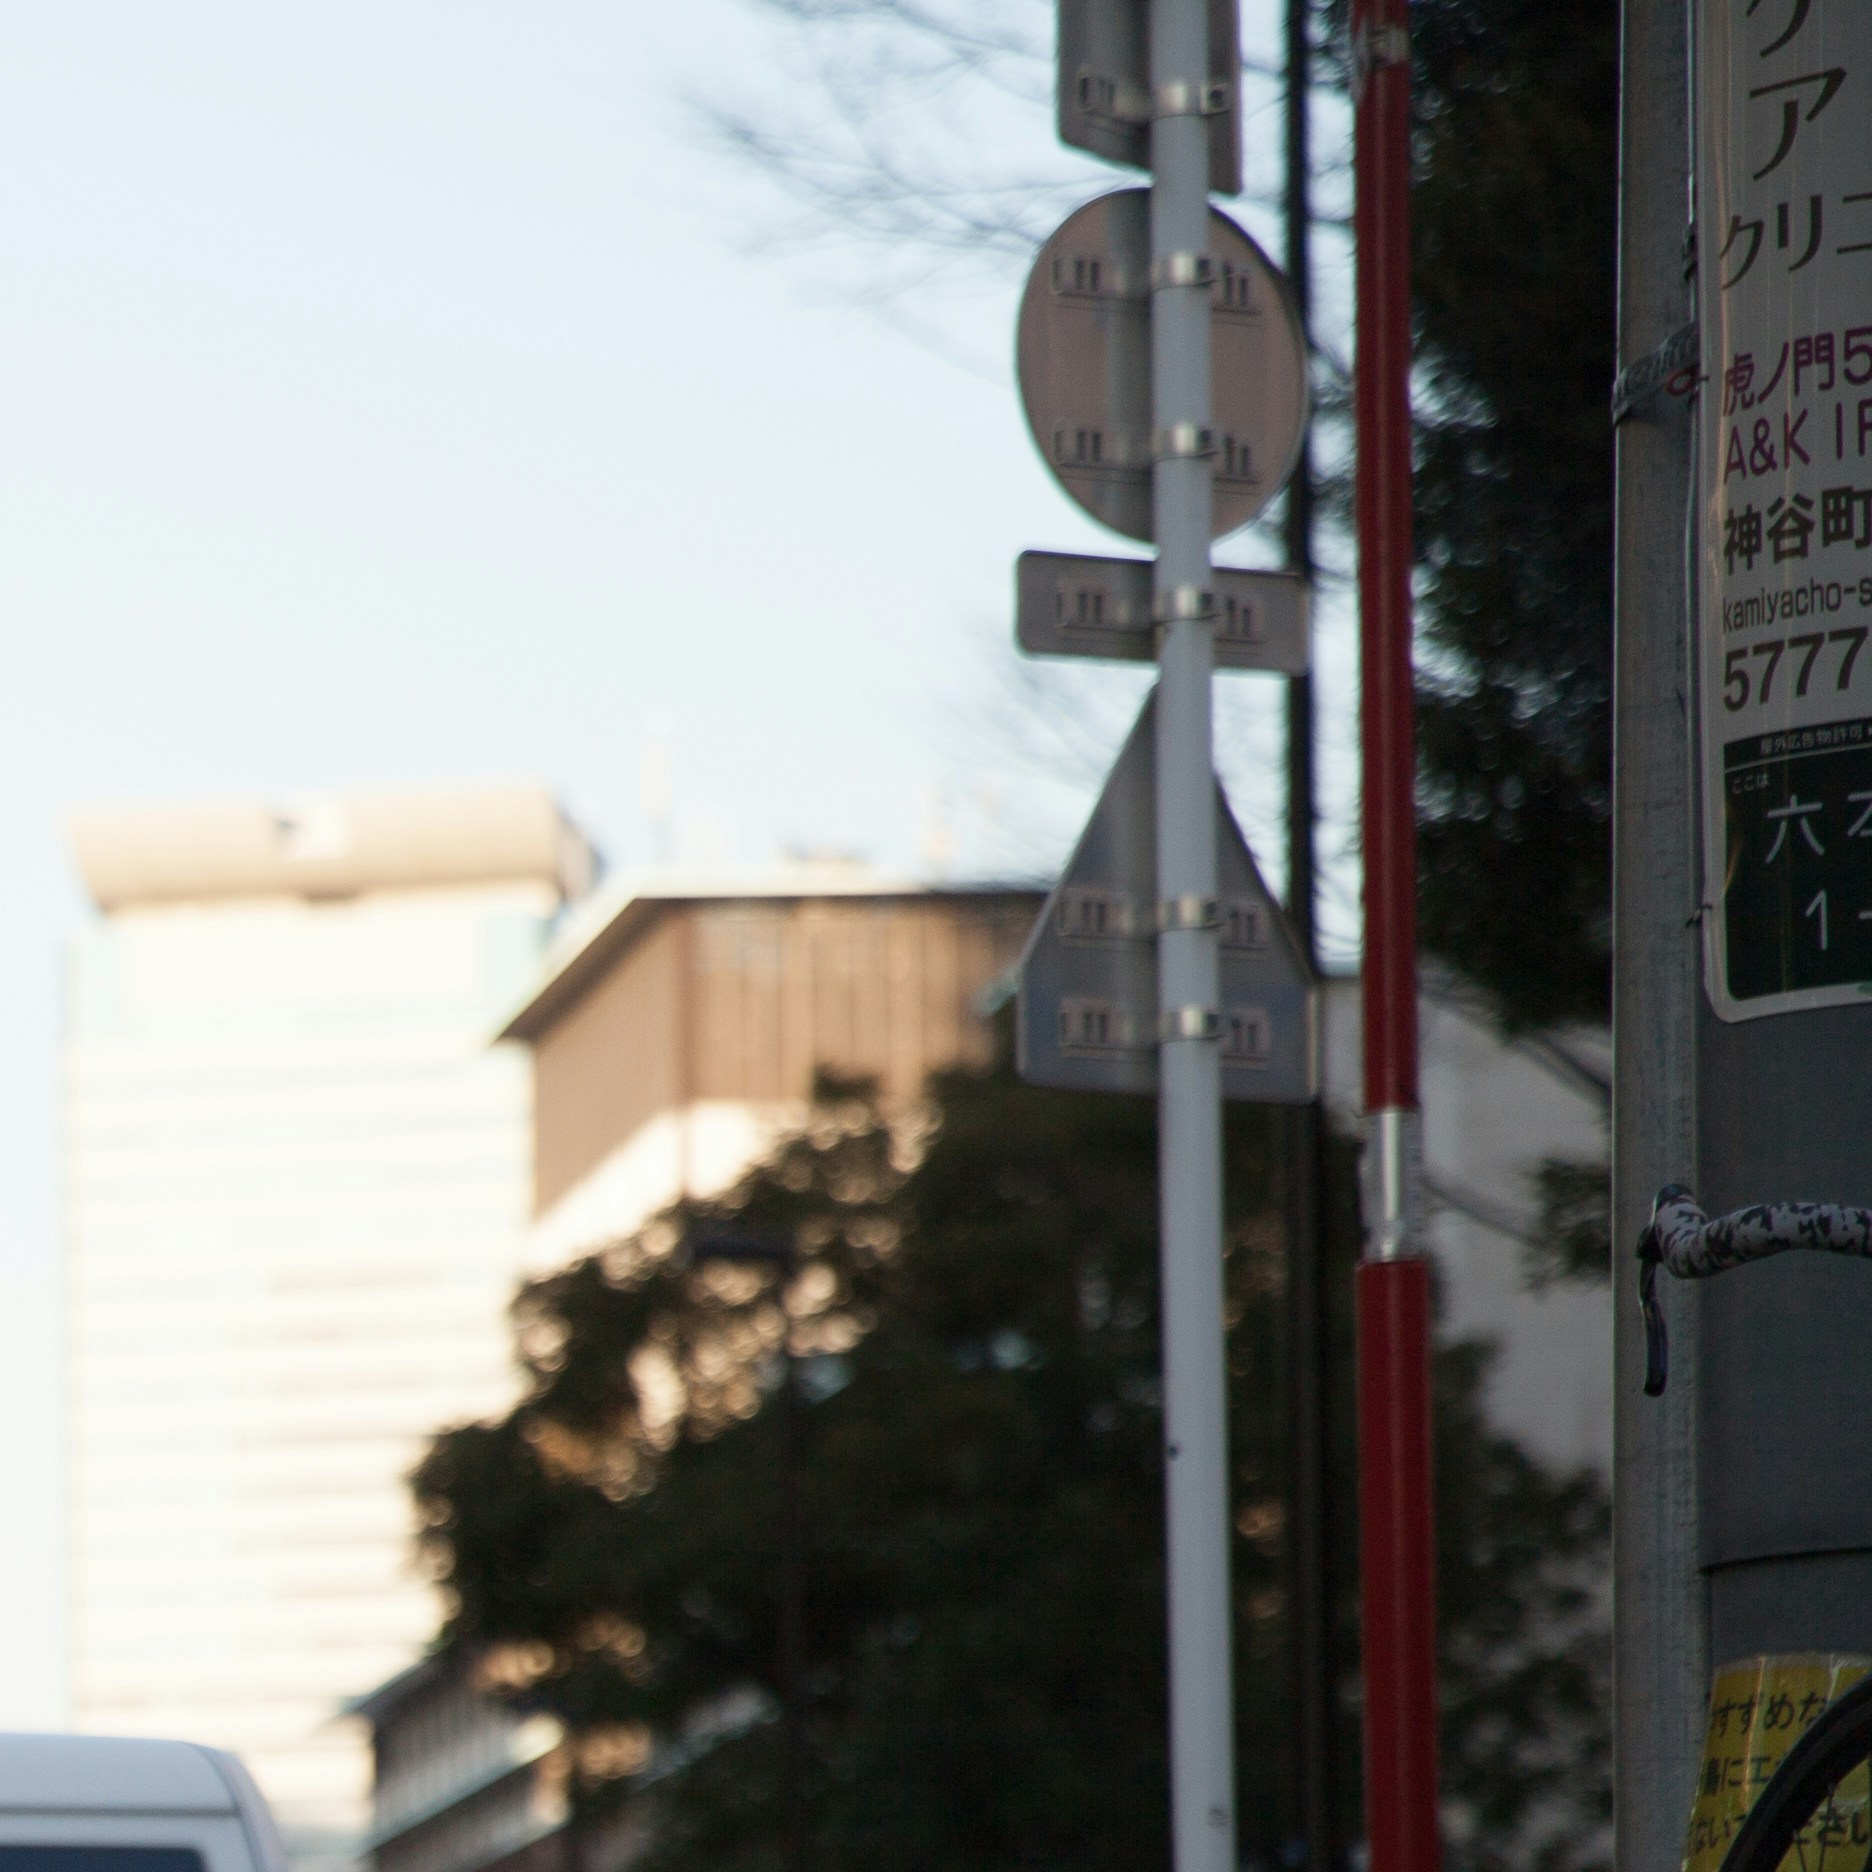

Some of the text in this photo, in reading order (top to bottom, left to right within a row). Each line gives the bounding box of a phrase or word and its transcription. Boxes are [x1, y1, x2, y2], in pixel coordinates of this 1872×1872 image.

[1724, 407, 1810, 484] A&K
[1723, 486, 1872, 576] 神谷町
[1723, 626, 1868, 712] 5777
